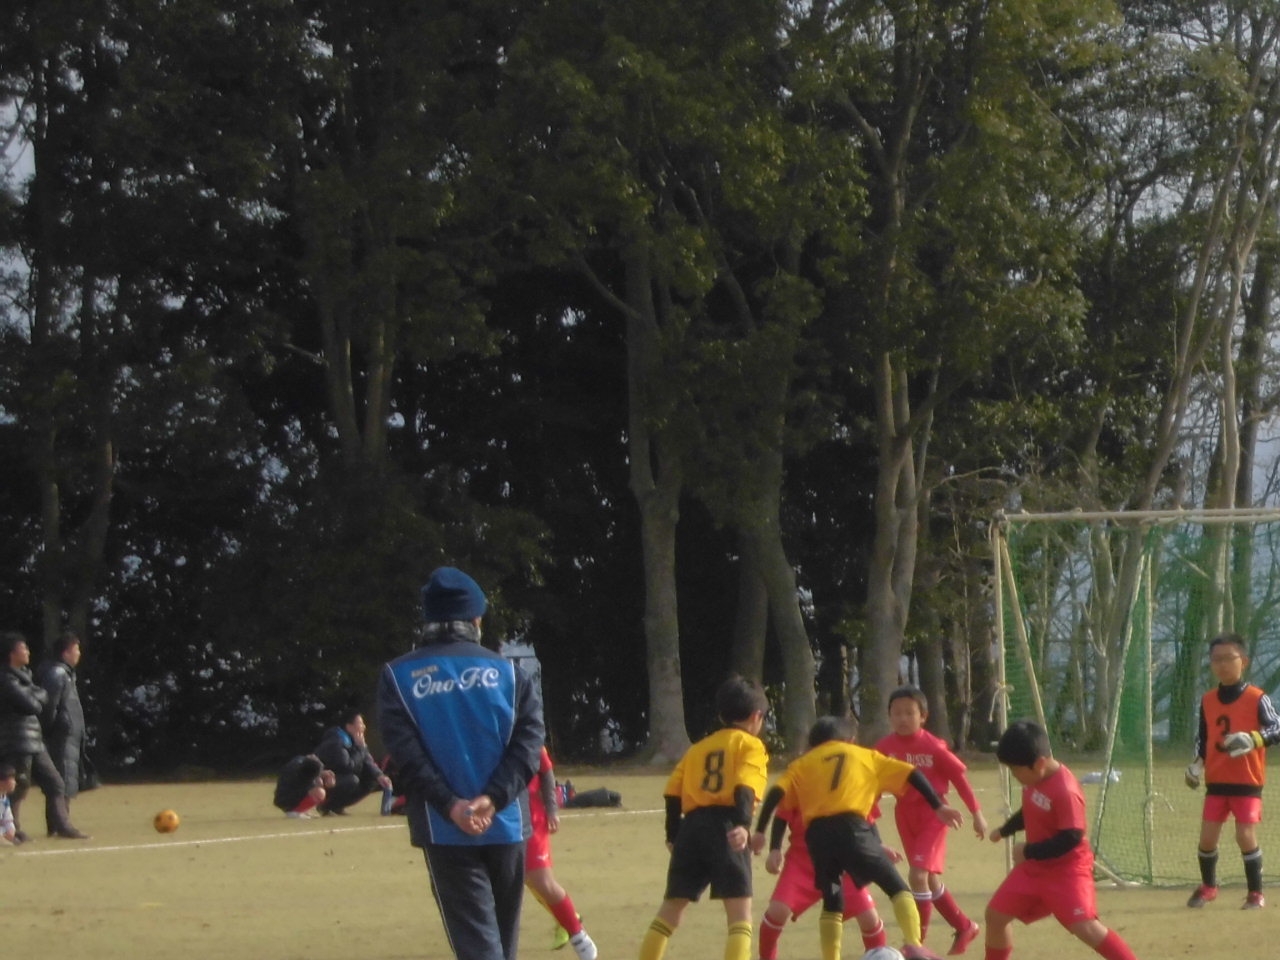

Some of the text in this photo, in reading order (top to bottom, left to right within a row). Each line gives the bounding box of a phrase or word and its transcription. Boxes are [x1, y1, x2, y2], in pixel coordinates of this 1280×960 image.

[413, 674, 454, 698] Ono
[702, 750, 724, 792] 8
[823, 753, 845, 791] 7
